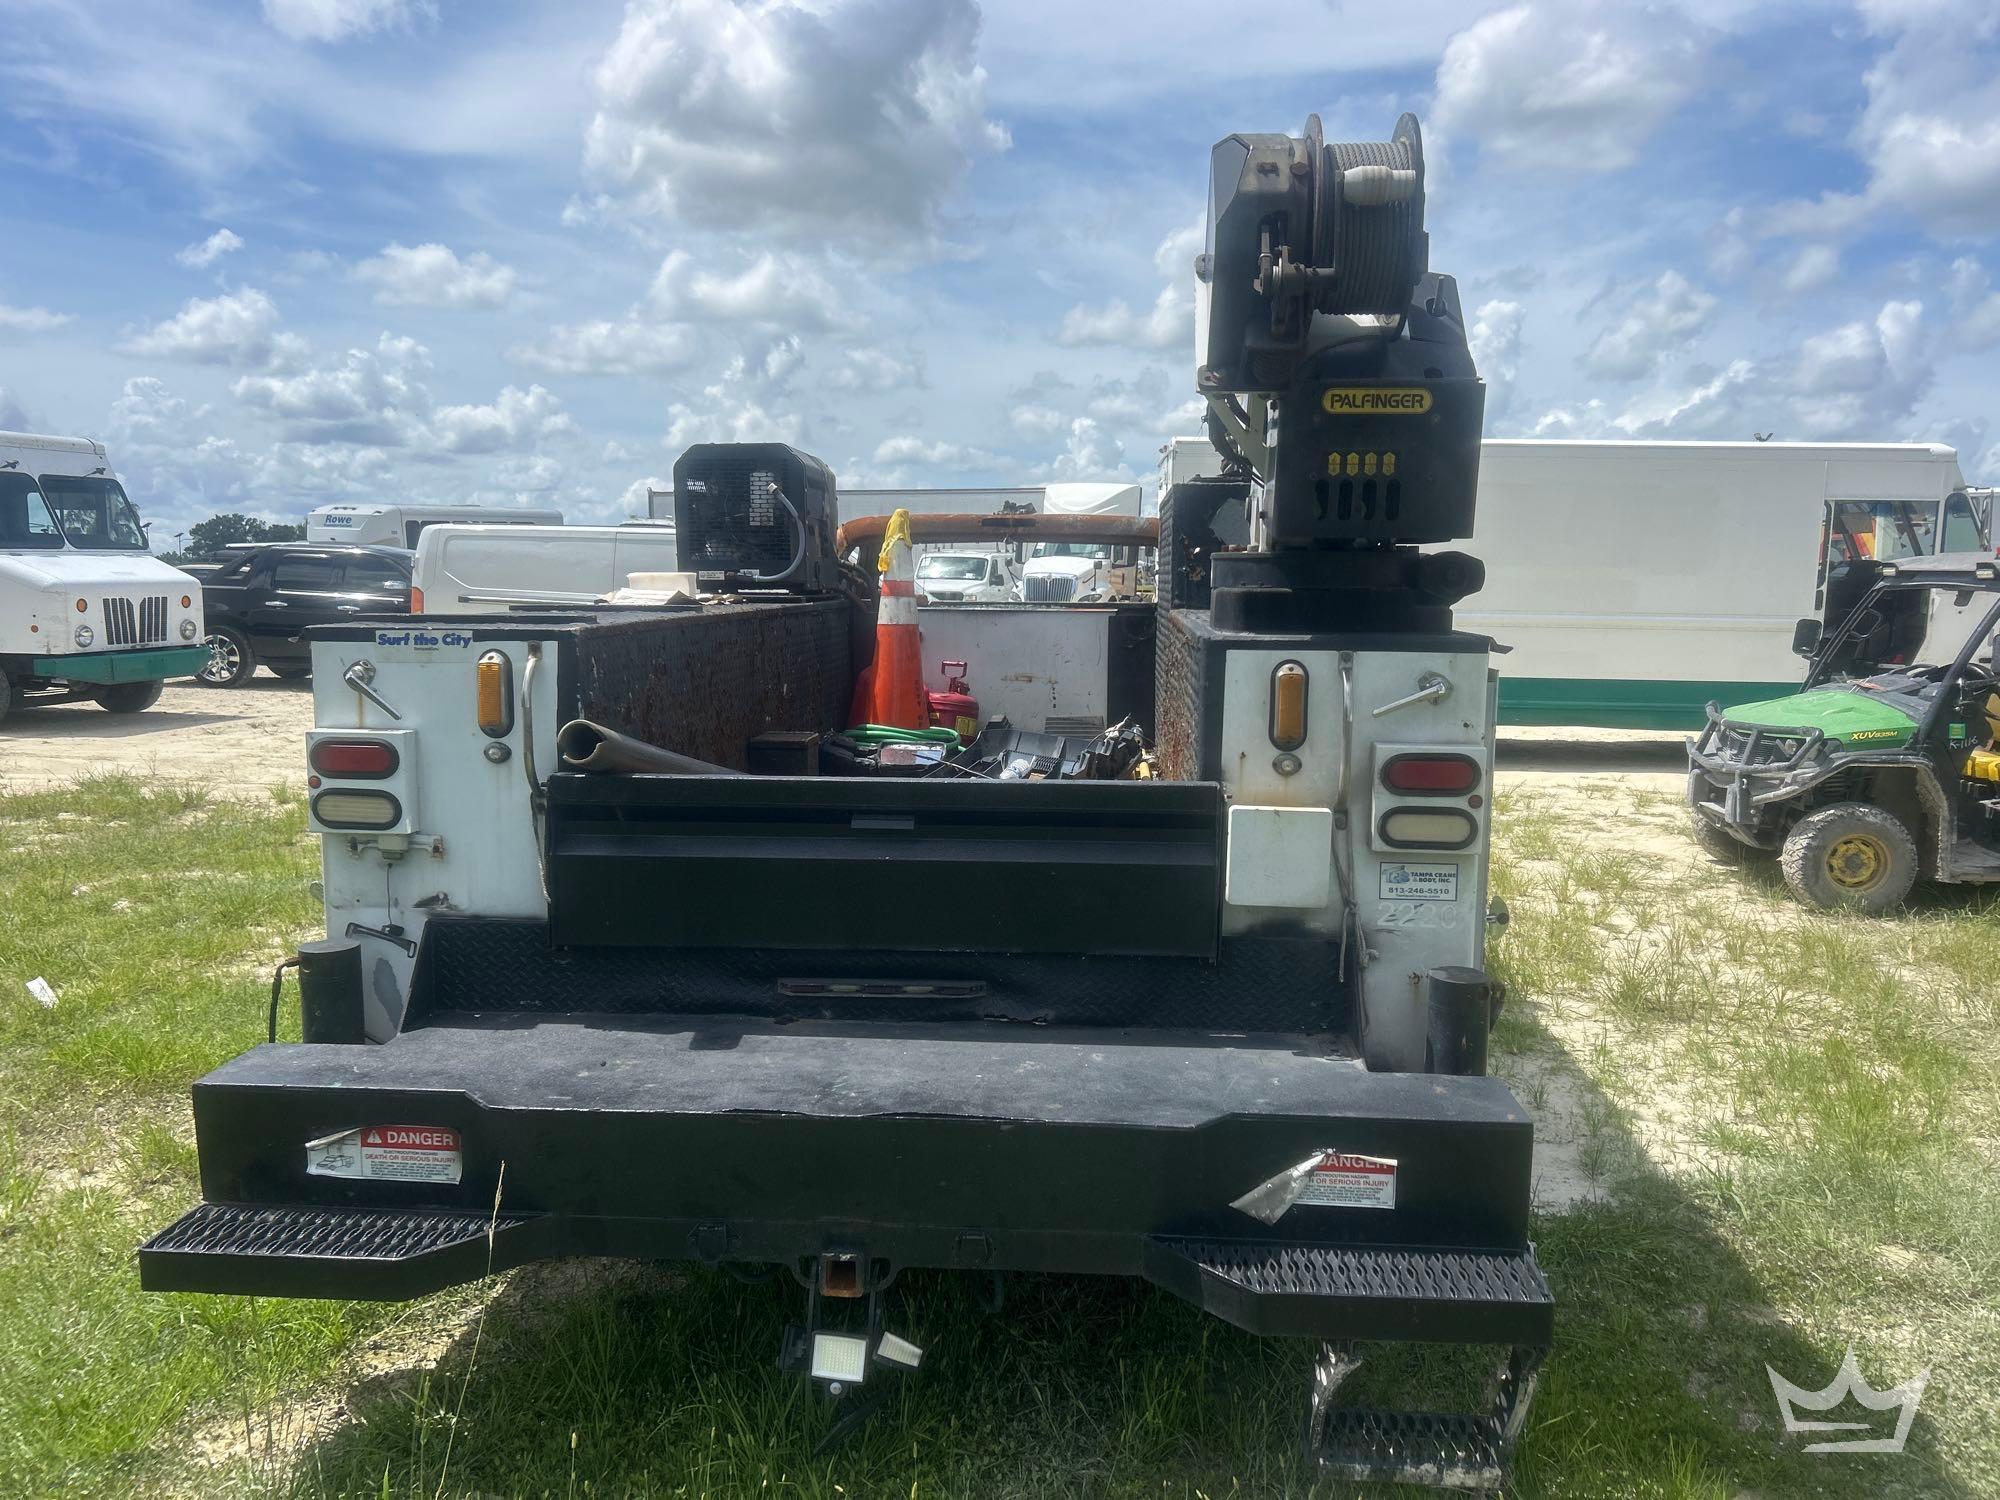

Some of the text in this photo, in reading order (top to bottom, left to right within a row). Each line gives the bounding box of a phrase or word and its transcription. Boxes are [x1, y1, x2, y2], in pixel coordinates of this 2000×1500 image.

[1330, 393, 1424, 409] PALFINGER
[325, 514, 352, 524] Rowe
[378, 632, 472, 648] Surf the City
[1388, 887, 1450, 895] 813-246-5510
[387, 1131, 454, 1146] DANGER
[400, 1155, 431, 1163] SERIOUS
